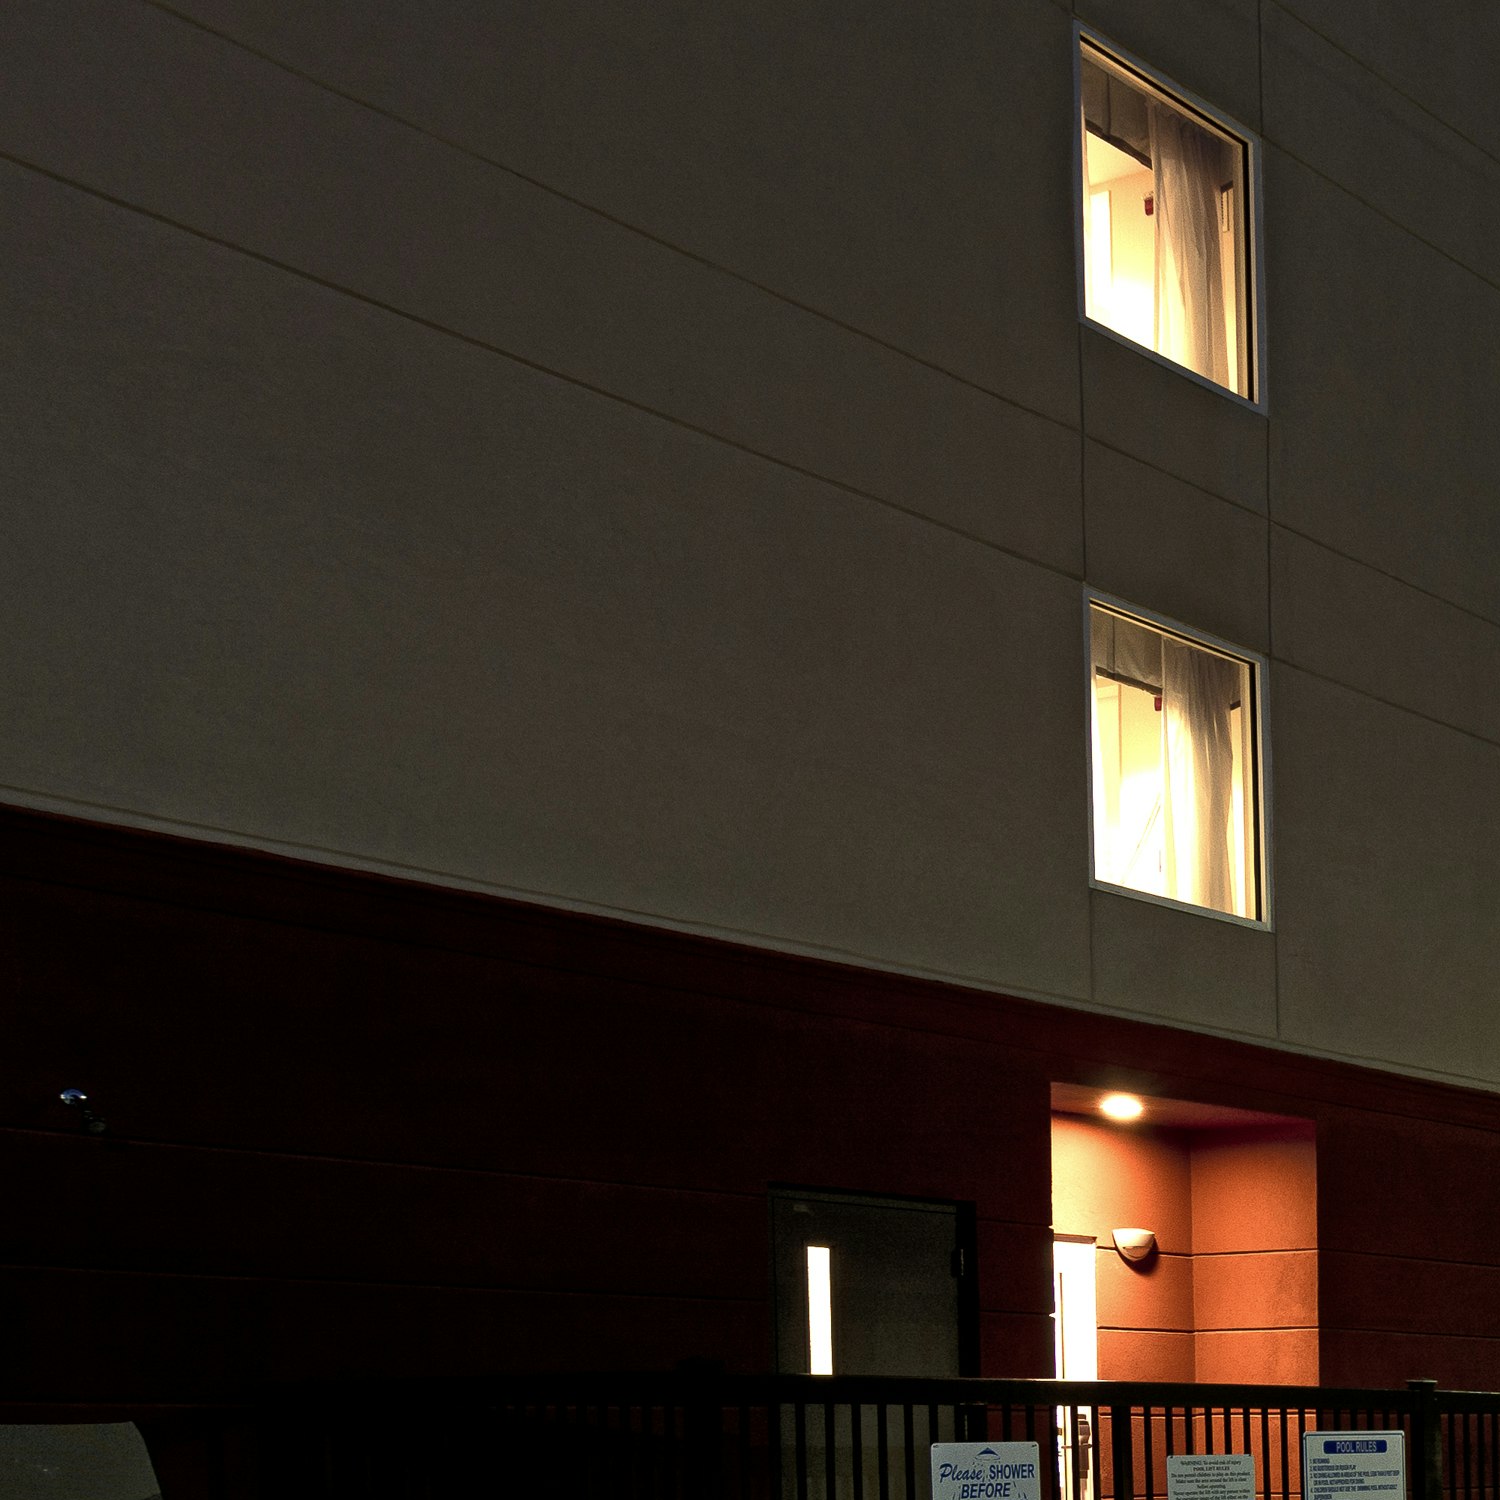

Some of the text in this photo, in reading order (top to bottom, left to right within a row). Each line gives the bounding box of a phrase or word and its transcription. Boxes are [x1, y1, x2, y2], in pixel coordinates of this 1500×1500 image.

[1336, 1442, 1377, 1452] POOL RULES
[940, 1463, 1035, 1483] Please SHOWER
[961, 1483, 1011, 1498] BEFORE
